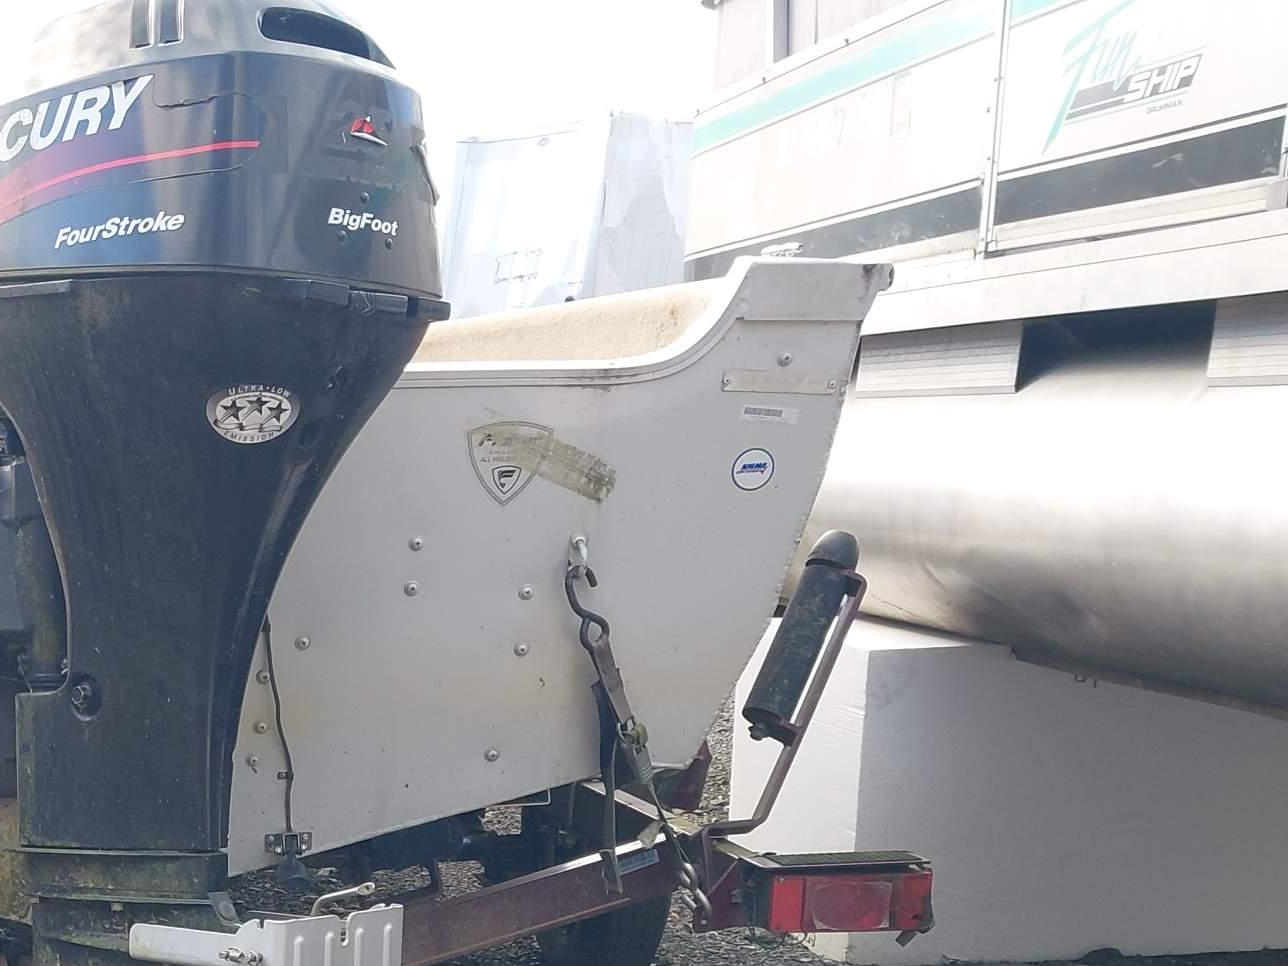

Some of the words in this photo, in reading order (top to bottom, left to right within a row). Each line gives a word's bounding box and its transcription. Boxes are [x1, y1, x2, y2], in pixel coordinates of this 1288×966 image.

[1124, 54, 1203, 104] SHIP
[54, 211, 185, 249] FourStroke
[327, 207, 399, 236] BigFoot
[224, 431, 274, 442] EMISSION
